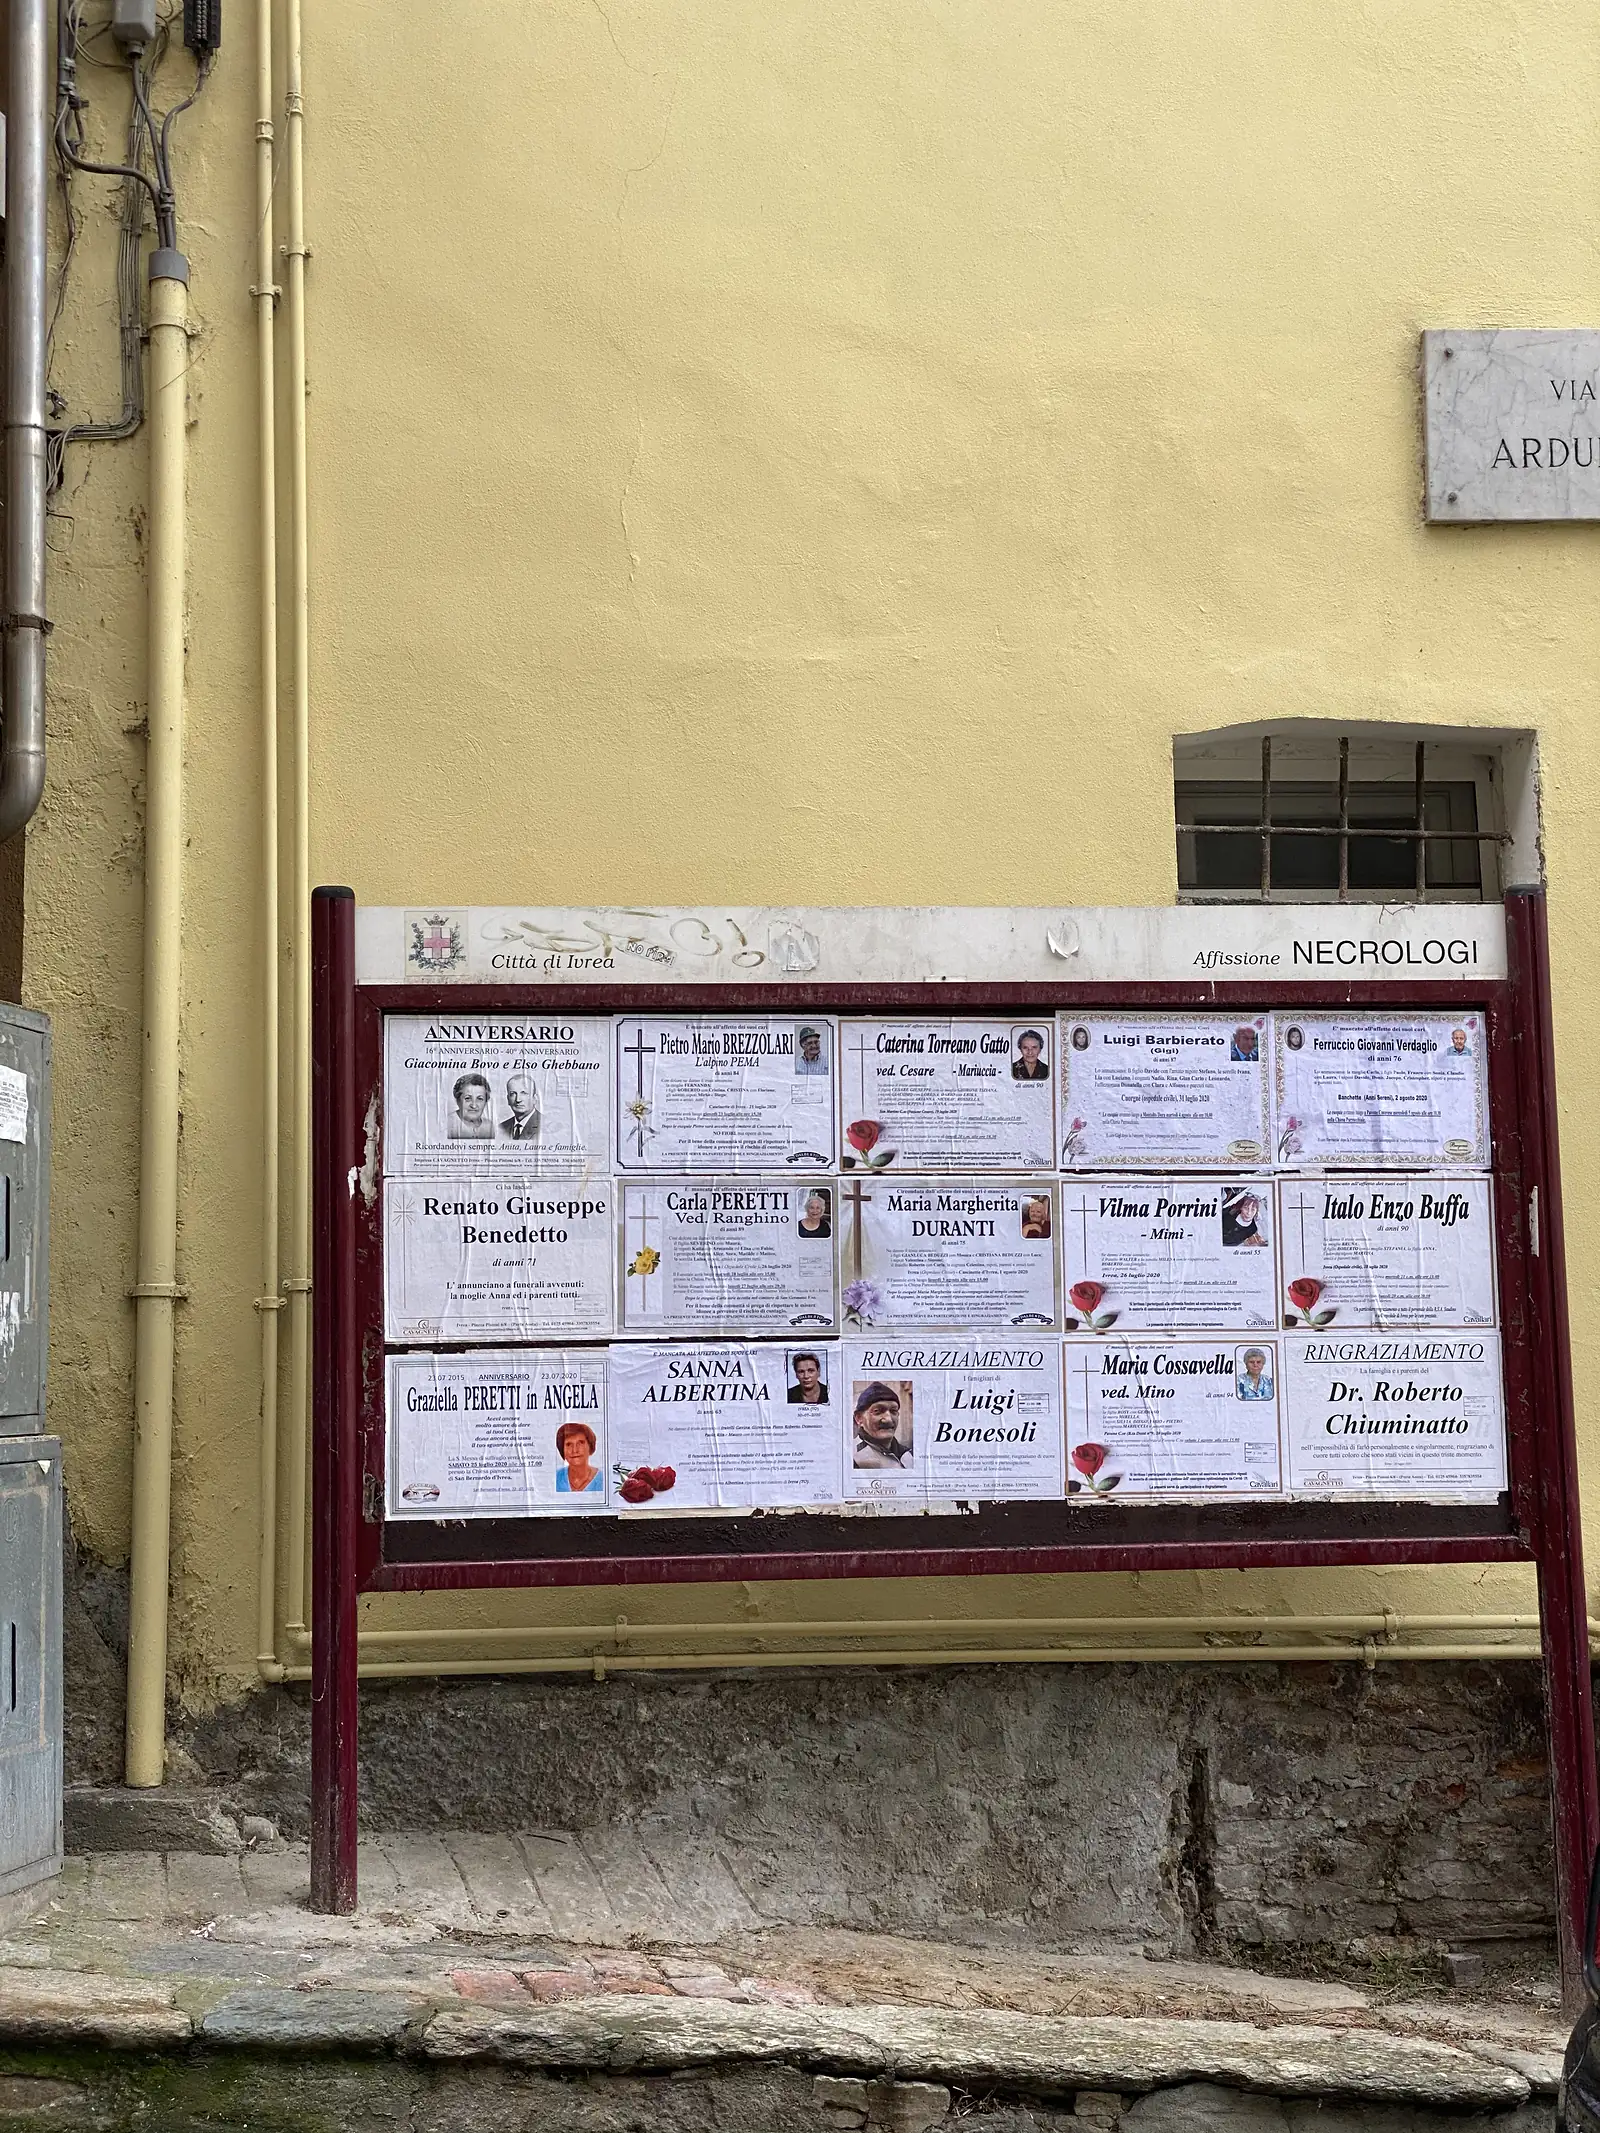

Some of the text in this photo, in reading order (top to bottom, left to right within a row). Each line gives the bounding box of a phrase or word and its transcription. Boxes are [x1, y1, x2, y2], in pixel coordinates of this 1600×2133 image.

[1550, 380, 1596, 400] VIA
[1491, 438, 1600, 468] ARDU
[627, 941, 644, 954] NO
[1193, 940, 1477, 967] Affissione NECROLOGI
[491, 953, 615, 970] Città di Ivrea
[425, 1026, 574, 1041] ANNIVERSARIO
[1104, 1035, 1224, 1046] Luigi Barbierato
[660, 1034, 793, 1055] Pietro Mario BREZZOLARI
[876, 1033, 1009, 1054] Caterina Torreano Gatto
[1314, 1039, 1437, 1054] Ferruccio Giovanni Verdaglio
[404, 1058, 466, 1070] Giacomina
[471, 1058, 499, 1069] Bovo
[513, 1059, 537, 1070] Elso
[542, 1059, 599, 1070] Ghebbano
[696, 1057, 759, 1069] L'alpino PEMA
[876, 1065, 934, 1076] ved. Cesare
[958, 1064, 996, 1076] Mariuccia
[500, 1144, 521, 1152] Anita,
[555, 1143, 587, 1152] famiglie.
[424, 1197, 605, 1219] Renato Giuseppe
[667, 1193, 788, 1210] Carla PERETTI
[887, 1195, 1018, 1214] Maria Margherita
[1100, 1198, 1217, 1217] Vilma Porrini
[1322, 1194, 1469, 1226] Italo Enzo Buffa
[676, 1213, 789, 1225] Ved. Ranghino
[462, 1226, 568, 1244] Benedetto
[912, 1221, 994, 1236] DURANTI
[1150, 1229, 1184, 1240] Mimì
[504, 1259, 524, 1267] anni
[514, 1281, 545, 1289] funerali
[451, 1292, 457, 1300] la
[460, 1292, 486, 1301] moglie
[529, 1292, 558, 1301] parenti
[862, 1351, 1043, 1367] RINGRAZIAMENTO
[1304, 1344, 1484, 1360] RINGRAZIAMENTO
[668, 1361, 744, 1379] SANNA
[1101, 1354, 1233, 1375] Maria Cossavella
[1369, 1367, 1390, 1375] famiglia
[408, 1385, 598, 1412] Graziella PERETTI in ANGELA
[641, 1383, 770, 1402] ALBERTINA
[1101, 1386, 1175, 1398] ved. Mino
[1328, 1382, 1462, 1402] Dr. Roberto
[952, 1389, 1015, 1415] Luigi
[1326, 1414, 1468, 1434] Chiuminatto
[935, 1422, 1036, 1443] Bonesoli
[1371, 1444, 1409, 1452] personalmente
[1457, 1444, 1487, 1452] ringraziano
